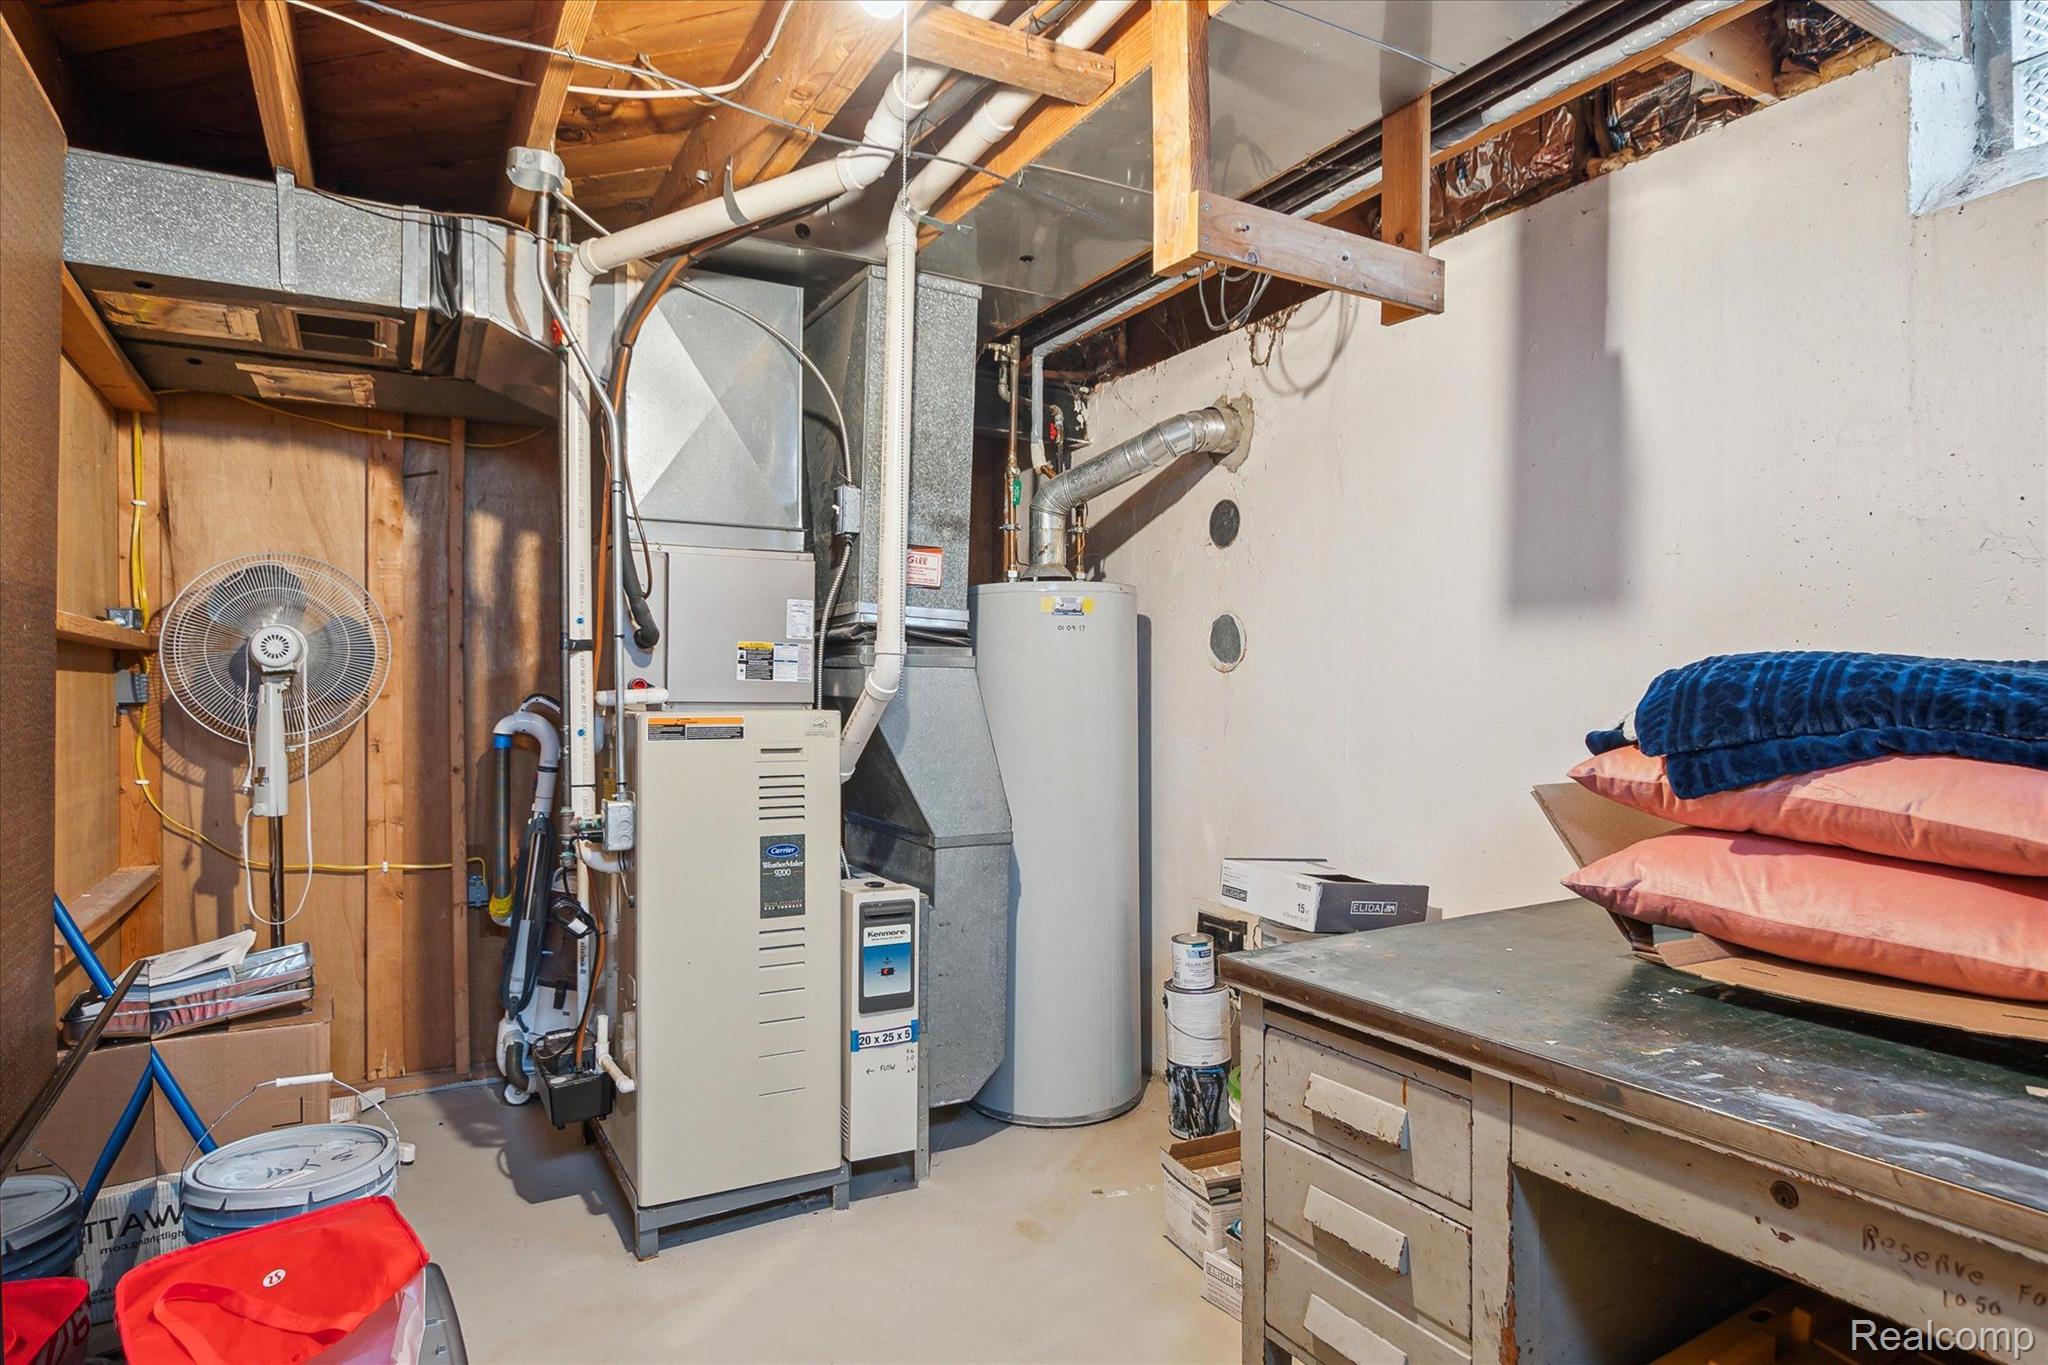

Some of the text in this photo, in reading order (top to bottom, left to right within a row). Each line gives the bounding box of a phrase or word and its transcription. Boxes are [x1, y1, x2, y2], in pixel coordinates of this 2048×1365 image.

[770, 846, 796, 855] Carrier
[762, 860, 804, 869] WeatherMaker
[774, 868, 792, 877] 9200
[1352, 902, 1382, 914] ELIDA
[867, 930, 906, 938] Kenmore
[859, 1029, 911, 1046] 20 x 25 x 5
[1206, 1263, 1233, 1284] ELIDA
